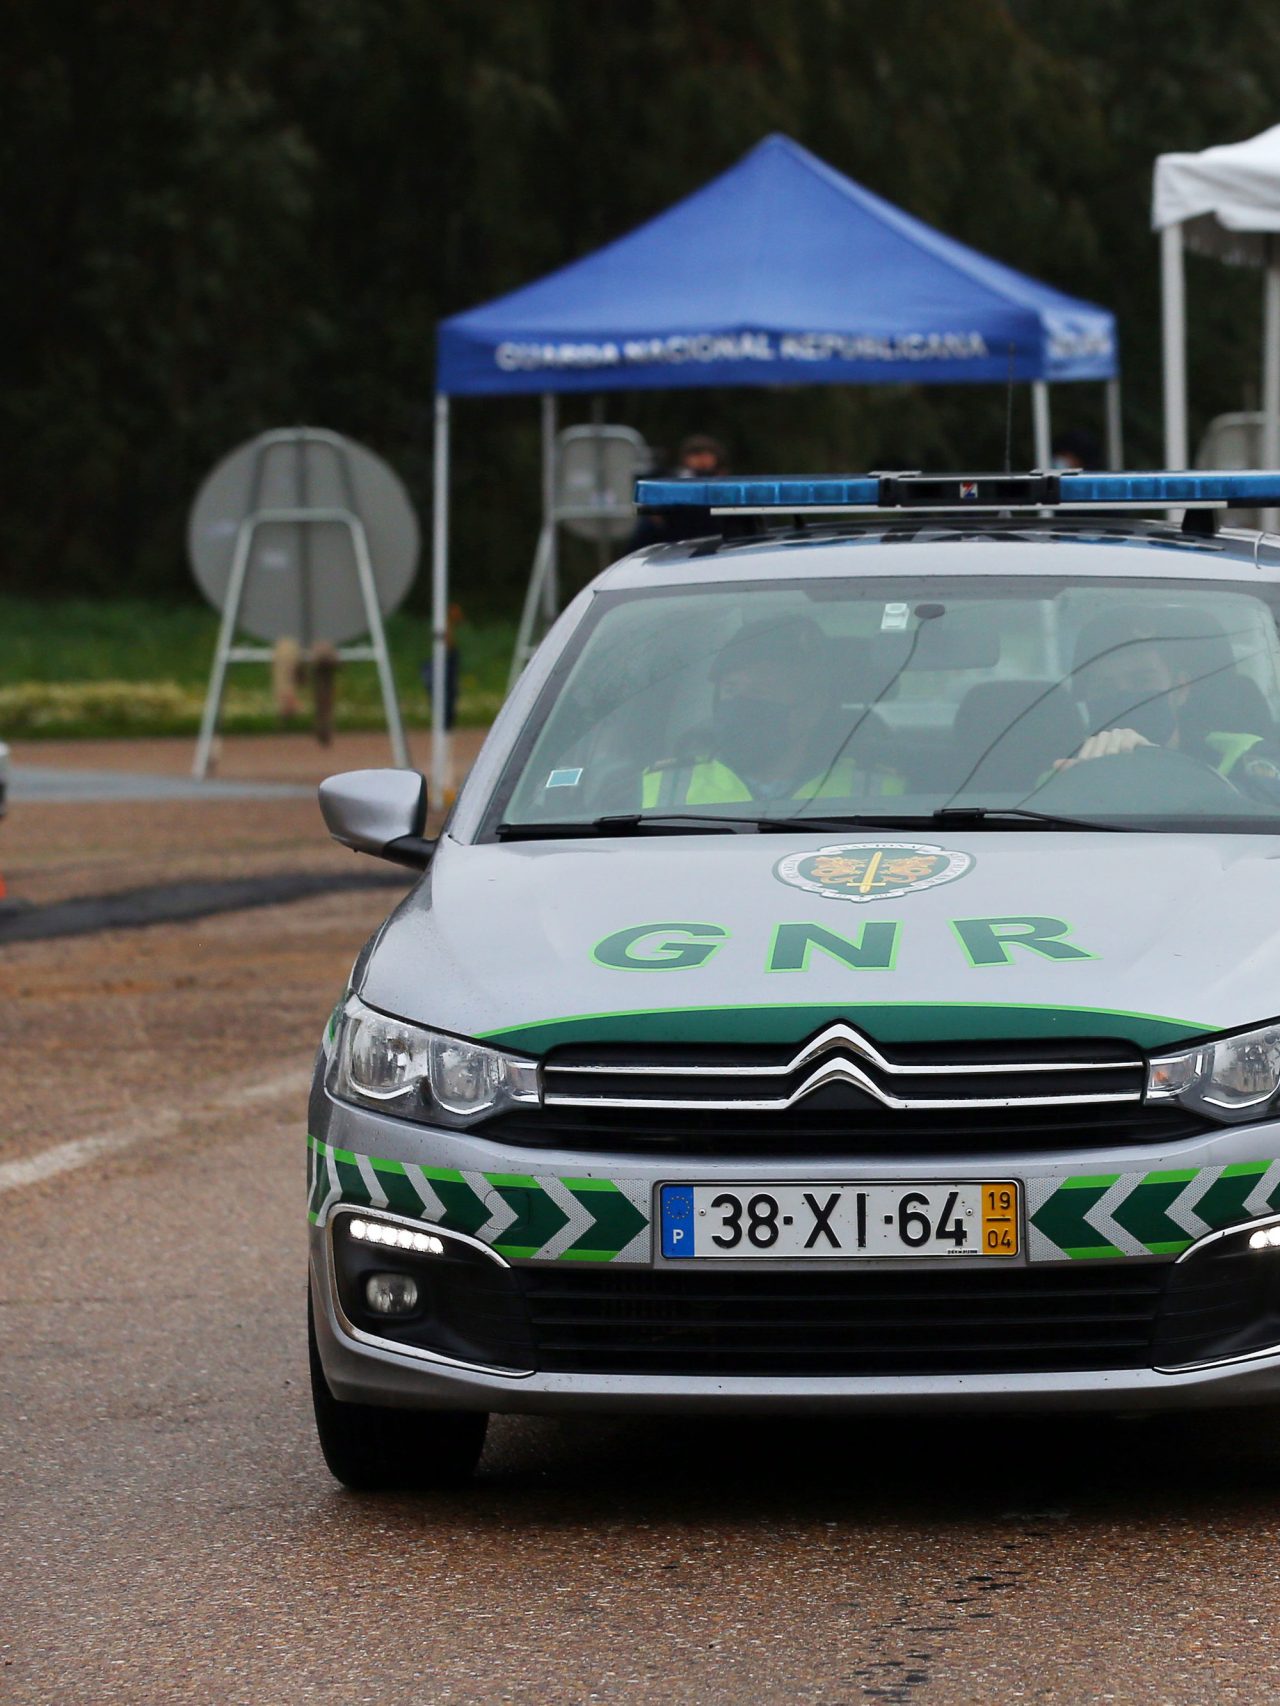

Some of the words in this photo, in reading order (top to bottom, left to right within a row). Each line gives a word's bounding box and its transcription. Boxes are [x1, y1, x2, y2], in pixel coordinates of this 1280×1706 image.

[623, 331, 774, 364] NACIONAL
[779, 330, 988, 361] REPUBLICANA
[987, 1190, 1012, 1211] 19
[672, 1229, 684, 1245] P
[986, 1229, 1012, 1250] 04
